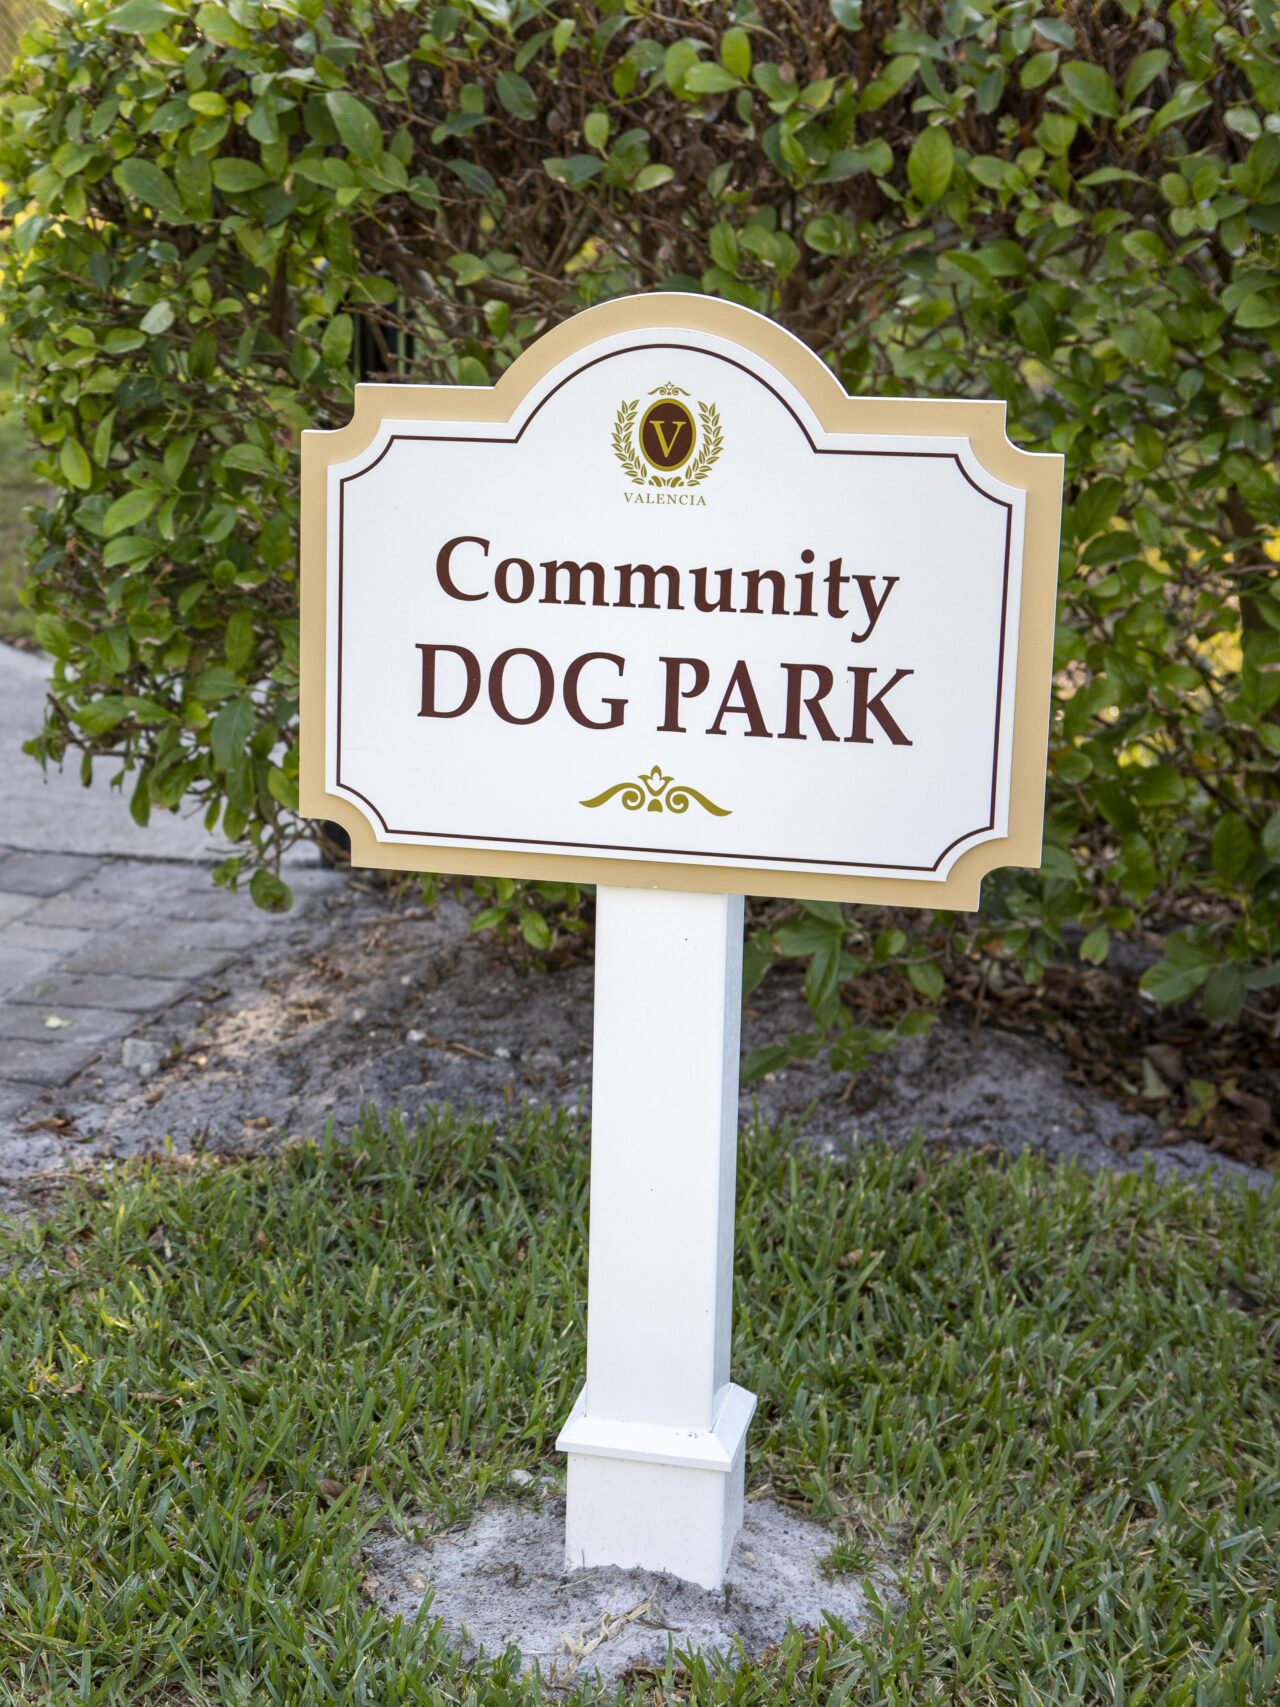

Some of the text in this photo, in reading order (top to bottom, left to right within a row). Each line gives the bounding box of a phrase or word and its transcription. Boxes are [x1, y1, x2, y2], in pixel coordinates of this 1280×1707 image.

[649, 420, 687, 458] V
[623, 492, 707, 506] VALENCIA
[435, 535, 900, 643] Community
[415, 643, 915, 746] DOG PARK
